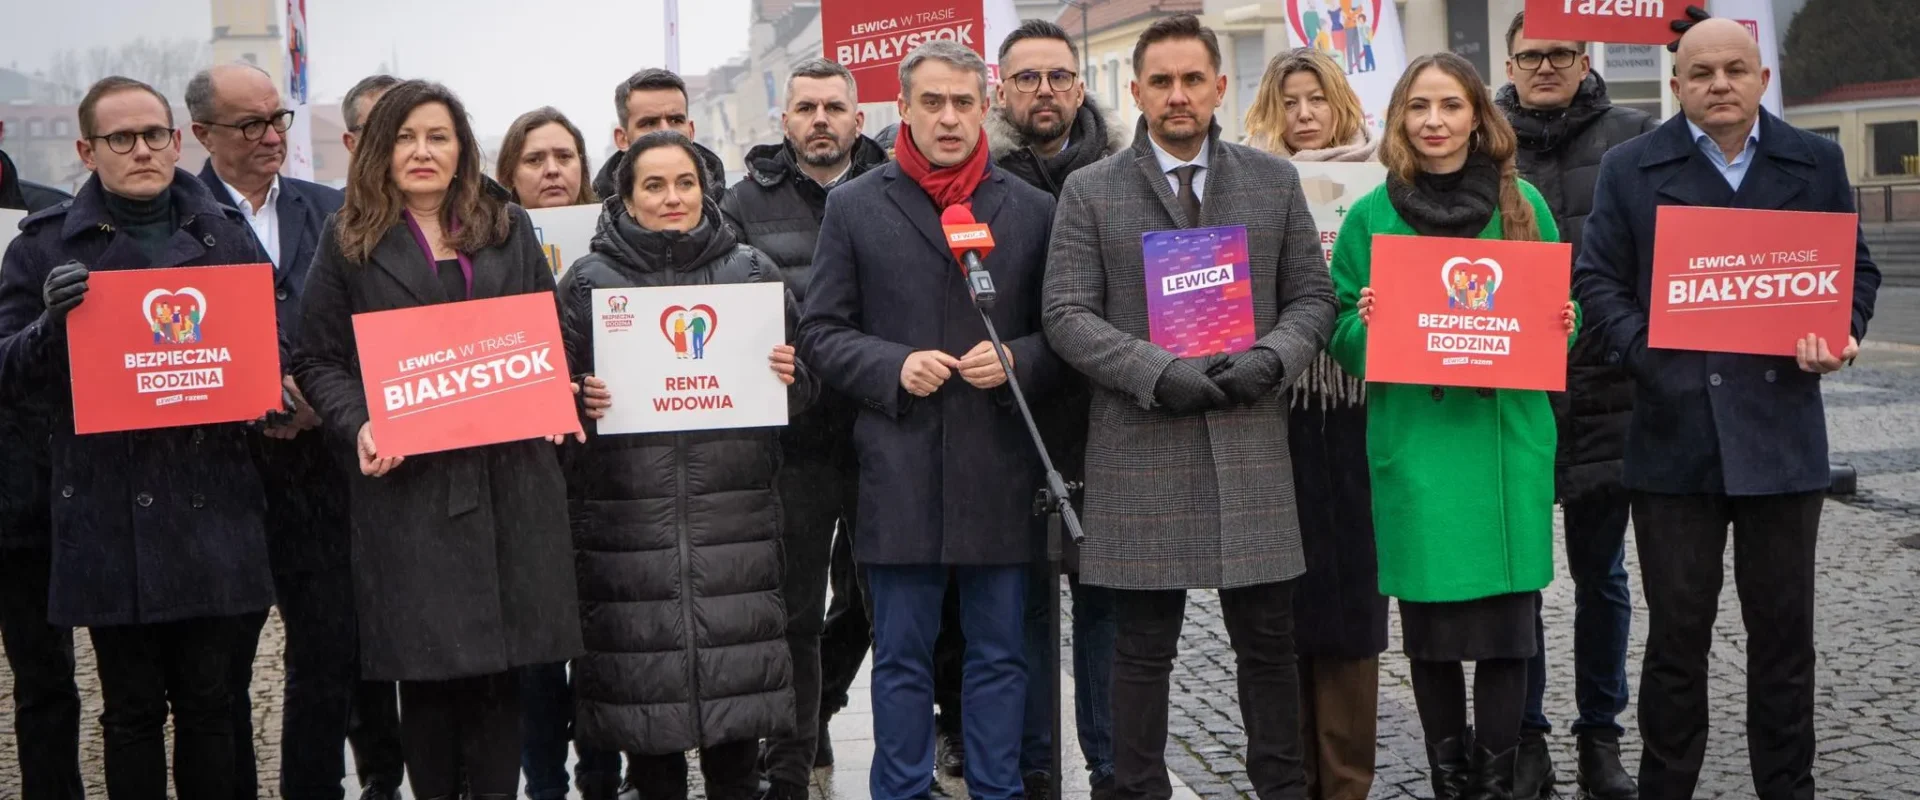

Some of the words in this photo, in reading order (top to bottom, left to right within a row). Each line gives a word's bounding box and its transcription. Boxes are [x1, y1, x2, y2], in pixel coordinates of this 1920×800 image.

[1563, 0, 1664, 18] razem
[851, 18, 898, 35] LEWICA
[900, 15, 913, 26] W
[917, 7, 956, 23] TRASIE
[1687, 255, 1746, 269] LEWICA
[1750, 253, 1766, 265] W
[1770, 249, 1819, 264] TRASIE
[1167, 267, 1231, 292] LEWICA
[1668, 270, 1841, 305] BIAŁYSTOK
[1418, 313, 1520, 332] BEZPIECZNA
[398, 348, 457, 372] LEWICA
[459, 344, 475, 358] W
[478, 330, 527, 352] TRASIE
[1430, 335, 1507, 352] RODZINA
[124, 347, 231, 369] BEZPIECZNA
[140, 370, 221, 390] RODZINA
[383, 347, 555, 412] BIAŁYSTOK
[665, 375, 719, 391] RENTA
[653, 395, 733, 412] WDOWIA
